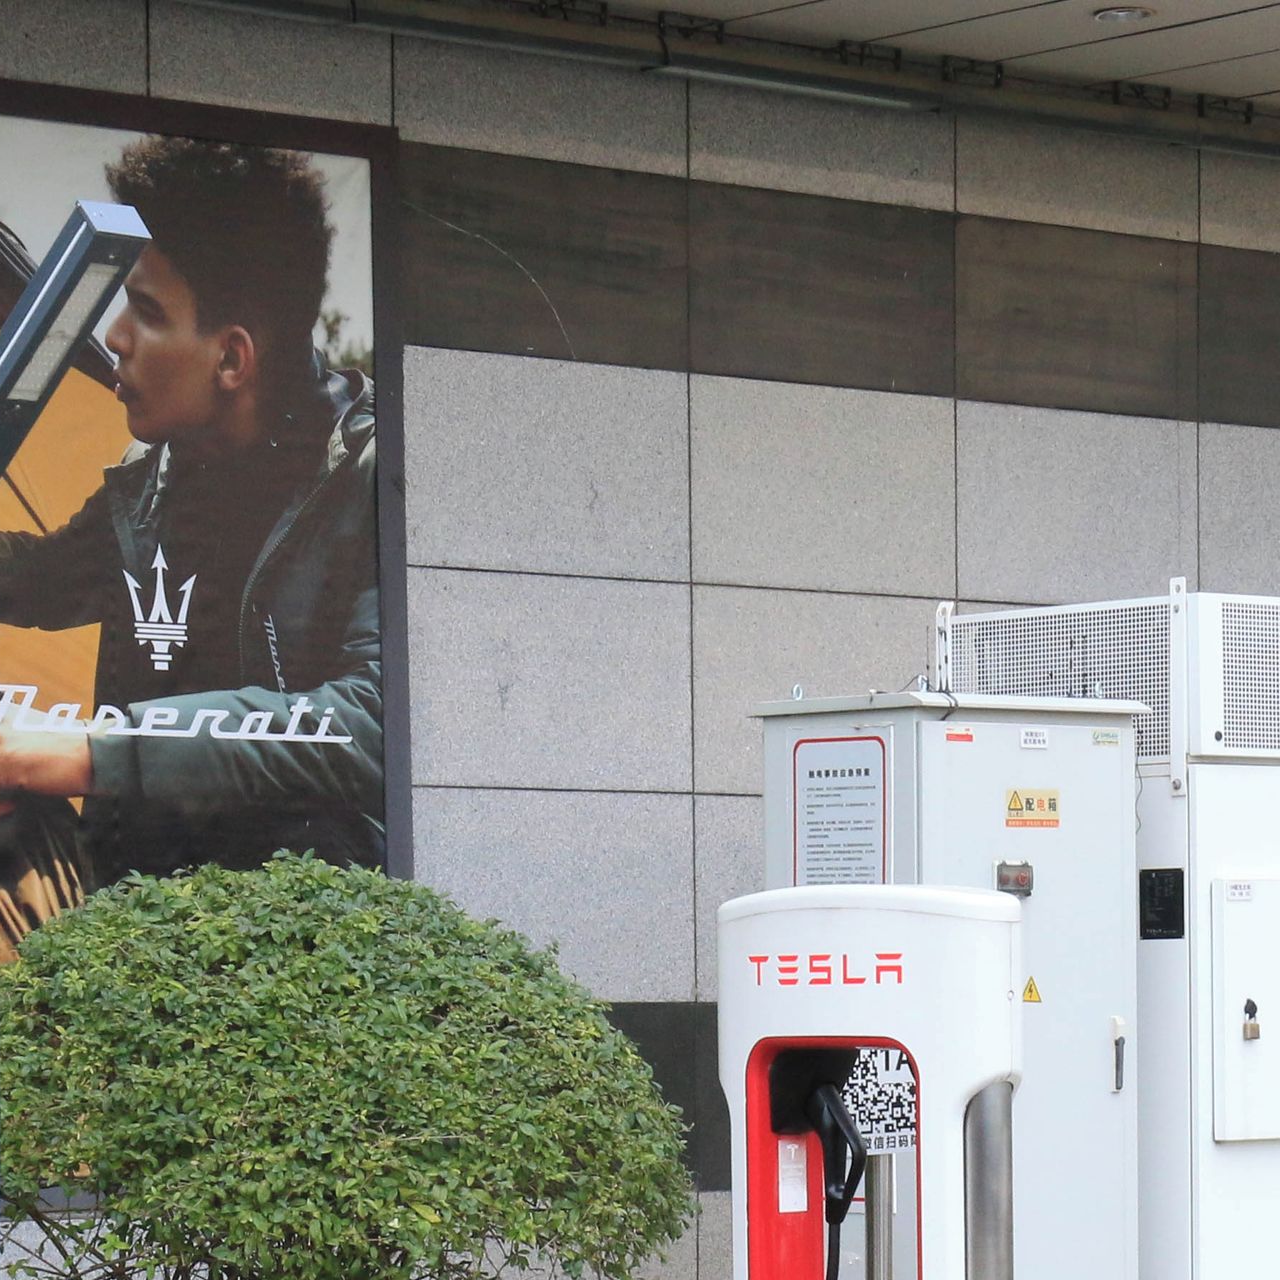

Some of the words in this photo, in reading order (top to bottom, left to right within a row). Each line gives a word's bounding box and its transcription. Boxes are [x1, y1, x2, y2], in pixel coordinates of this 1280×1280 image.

[1025, 797, 1057, 811] 配电箱
[747, 952, 903, 986] TESLA
